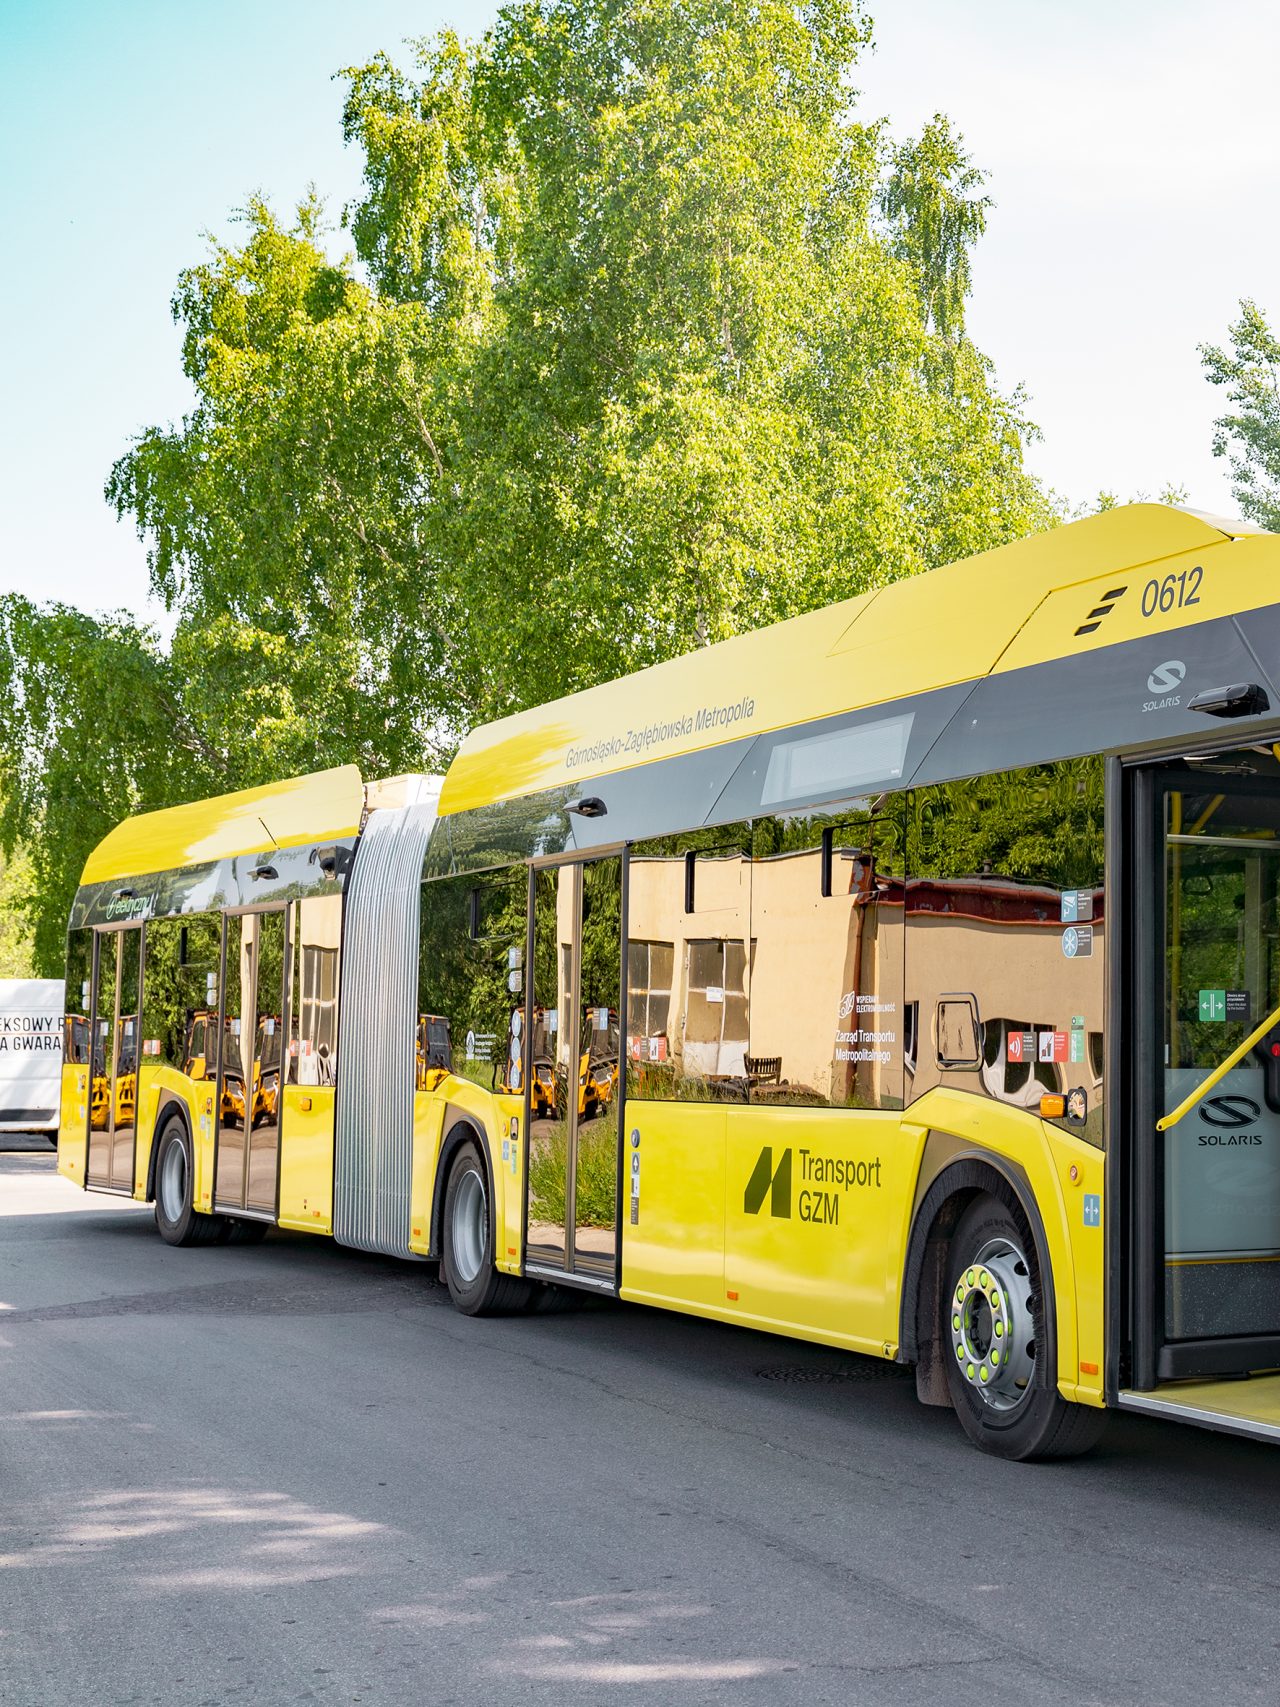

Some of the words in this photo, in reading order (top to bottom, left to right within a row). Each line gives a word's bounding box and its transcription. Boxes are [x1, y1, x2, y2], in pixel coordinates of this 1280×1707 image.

[1141, 566, 1203, 618] 0612
[1141, 695, 1181, 713] SOLARIS
[565, 714, 693, 768] Górnośląsko-Zagłębiowska
[694, 696, 755, 732] Metropolia
[835, 1029, 858, 1045] Zarząd
[858, 1029, 896, 1043] Transportu
[835, 1047, 891, 1065] Metropolitalnego
[1198, 1135, 1263, 1146] SOLARIS
[799, 1148, 881, 1192] Transport
[798, 1190, 839, 1226] GZM
